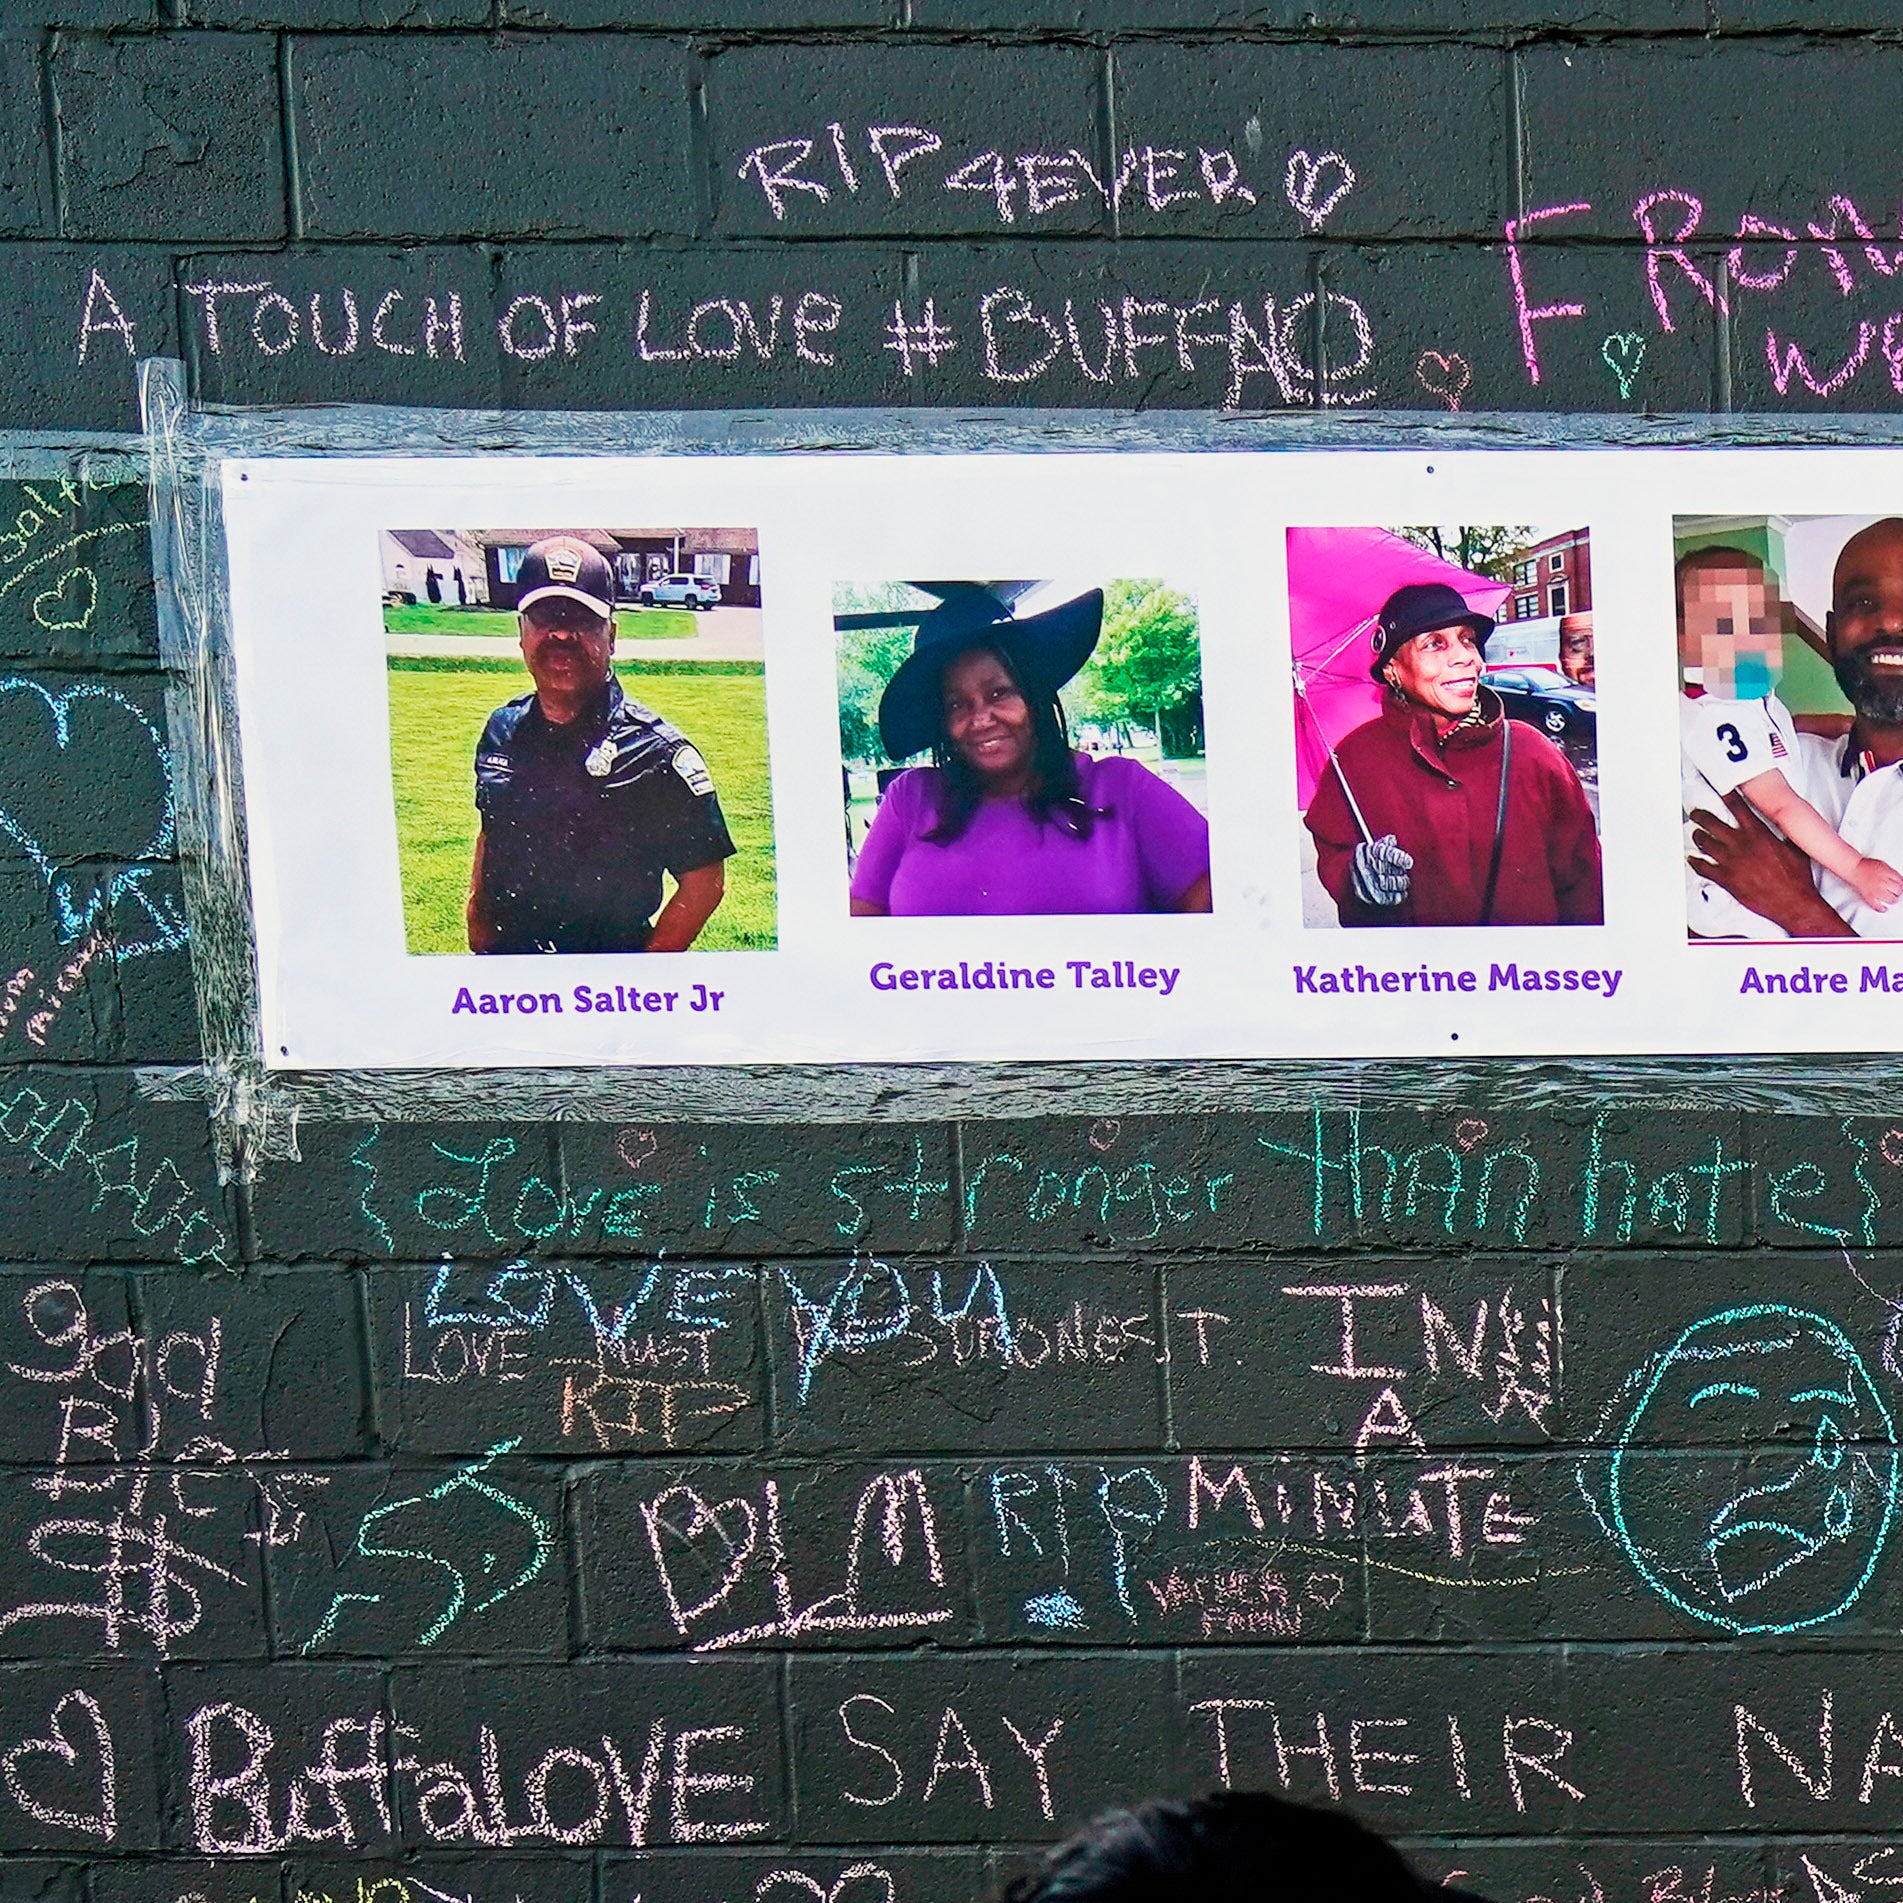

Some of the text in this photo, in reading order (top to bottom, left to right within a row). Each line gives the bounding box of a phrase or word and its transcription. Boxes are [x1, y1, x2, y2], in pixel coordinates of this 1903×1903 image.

[738, 122, 944, 222] RIP
[76, 267, 135, 365] A
[174, 278, 467, 364] TOUCH
[497, 290, 604, 362] OF
[1716, 722, 1749, 763] 3
[870, 962, 1182, 996] Geraldine Talley
[1293, 964, 1624, 999] Katherine Massey
[1740, 967, 1849, 995] Andre
[452, 985, 726, 1015] Aaron Salter Jr
[842, 1693, 1066, 1822] SAY
[1190, 1697, 1586, 1814] THEIR
